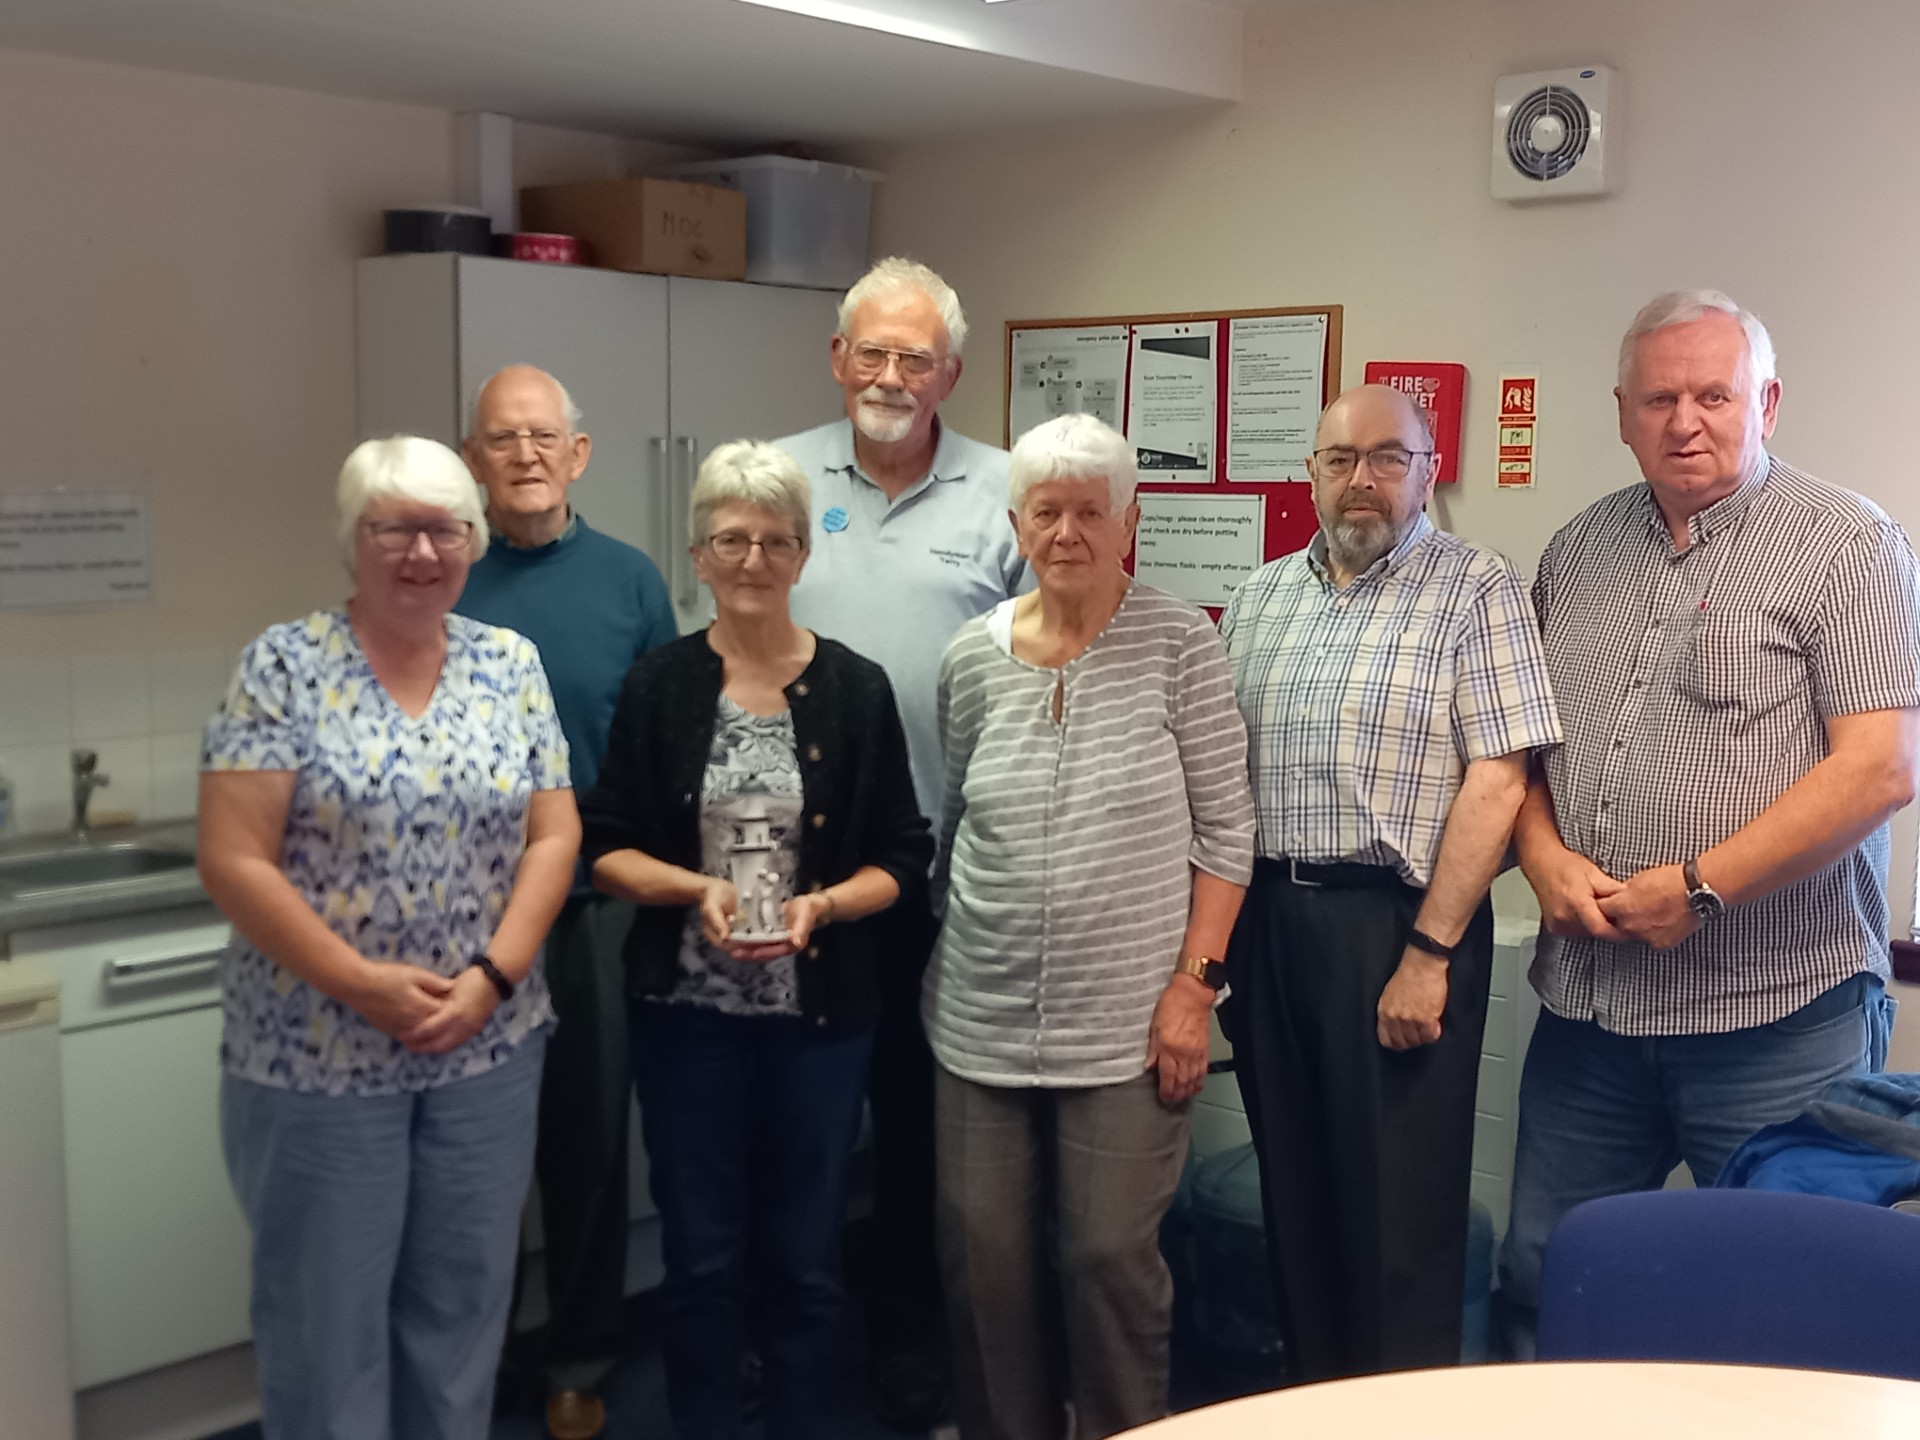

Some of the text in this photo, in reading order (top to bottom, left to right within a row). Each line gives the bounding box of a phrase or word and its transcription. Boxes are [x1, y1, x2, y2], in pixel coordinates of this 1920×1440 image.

[1390, 375, 1424, 392] FIRE
[1177, 515, 1197, 524] please
[1198, 515, 1215, 523] clean
[1216, 516, 1252, 525] thoroughly
[1182, 528, 1191, 536] dry
[1214, 529, 1238, 537] putting
[1179, 561, 1196, 569] flasks
[1201, 563, 1221, 571] empty
[1222, 562, 1238, 570] after
